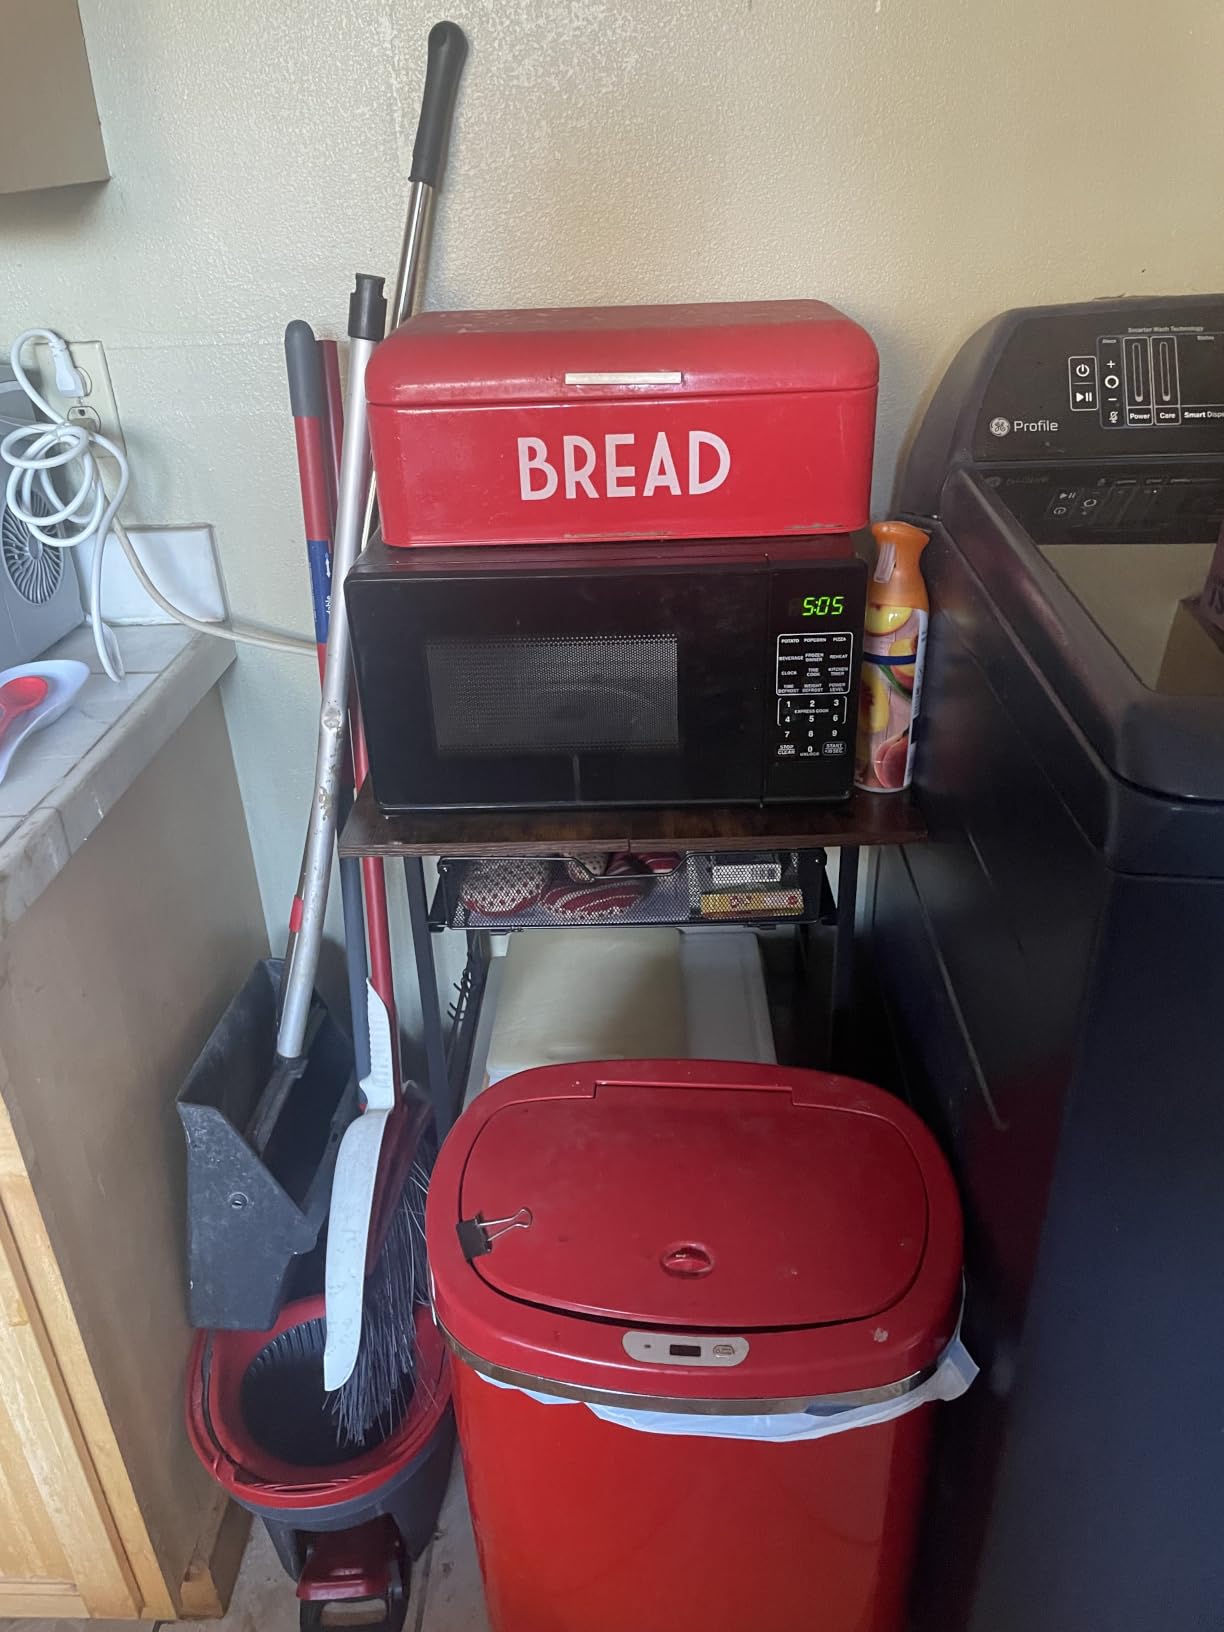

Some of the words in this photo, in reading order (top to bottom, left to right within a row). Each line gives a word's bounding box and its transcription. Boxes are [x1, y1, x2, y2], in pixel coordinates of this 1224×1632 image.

[1129, 412, 1150, 420] Power
[1013, 419, 1059, 432] Profile
[517, 430, 731, 501] BREAD
[802, 596, 844, 616] 5:05
[786, 700, 791, 708] 1
[809, 699, 816, 708] 2
[833, 698, 840, 707] 3
[784, 715, 791, 723] 4
[808, 714, 815, 723] 5
[832, 714, 839, 722] 6
[784, 730, 790, 738] 7
[808, 730, 814, 738] 8
[831, 729, 838, 737] 9
[807, 745, 813, 753] 0
